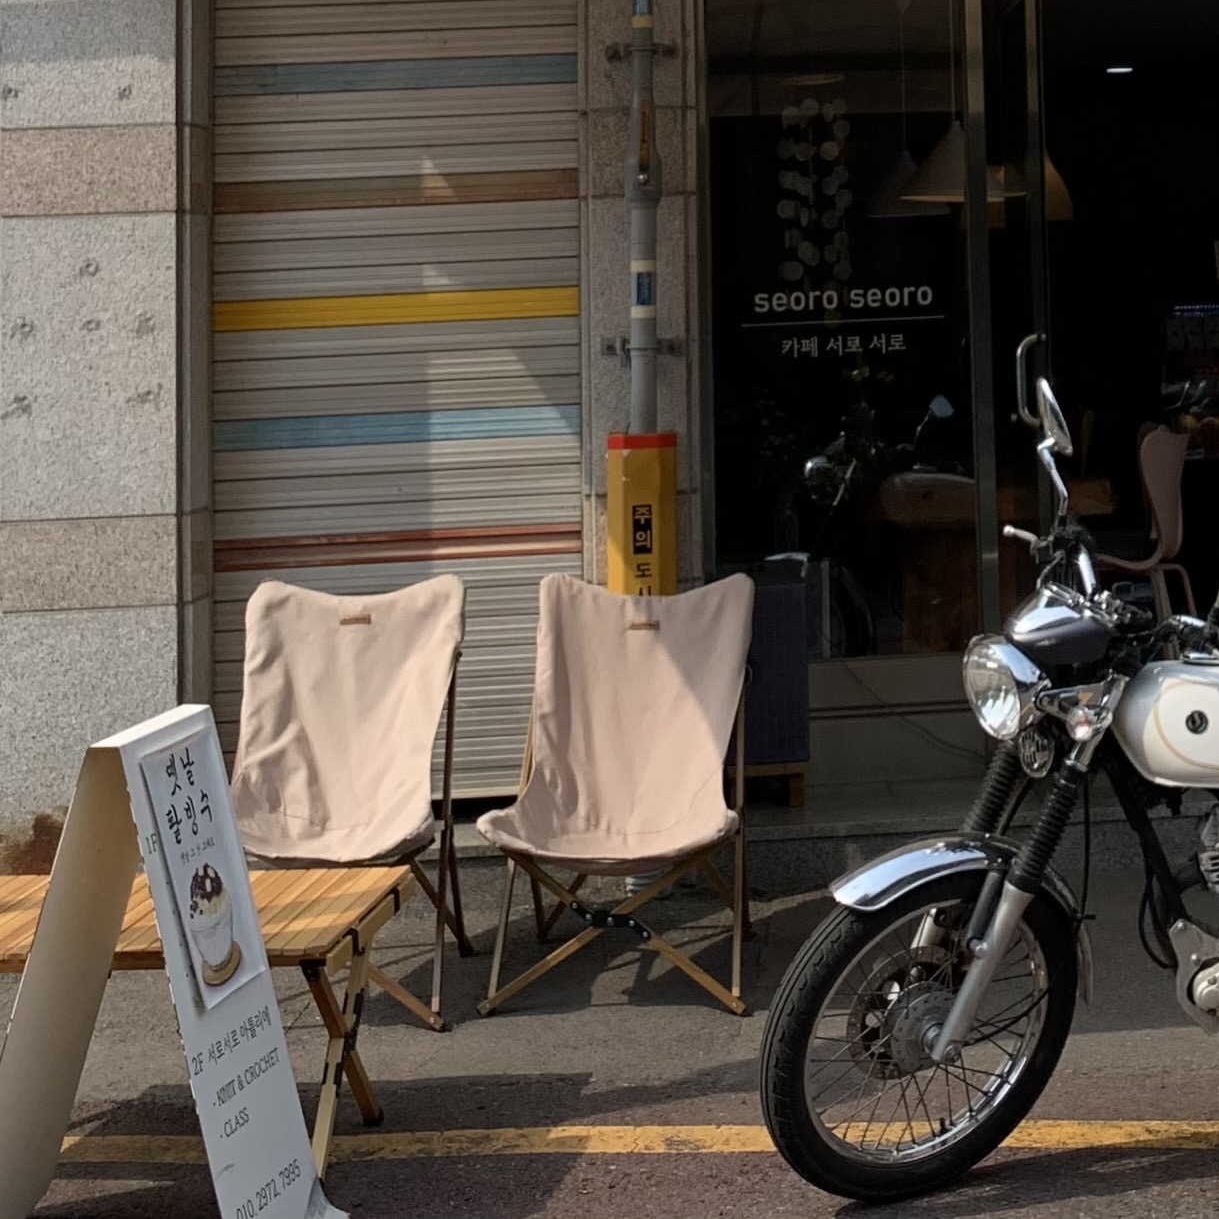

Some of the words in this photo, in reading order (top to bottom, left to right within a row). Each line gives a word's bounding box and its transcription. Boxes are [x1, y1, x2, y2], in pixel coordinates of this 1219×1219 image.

[754, 290, 838, 312] seoro
[850, 285, 933, 308] seoro
[781, 336, 818, 358] 카페
[826, 335, 863, 357] 서로
[869, 333, 906, 354] 서로
[634, 506, 651, 548] 주의
[165, 747, 194, 796] 옛날
[165, 789, 213, 844] 팥빙수
[192, 1052, 203, 1076] 2F
[208, 1030, 240, 1065] 서로서로
[239, 1005, 272, 1041] 아틀리에
[237, 1074, 245, 1091] &
[244, 1047, 279, 1085] CROCHET
[224, 1106, 249, 1138] CLASS
